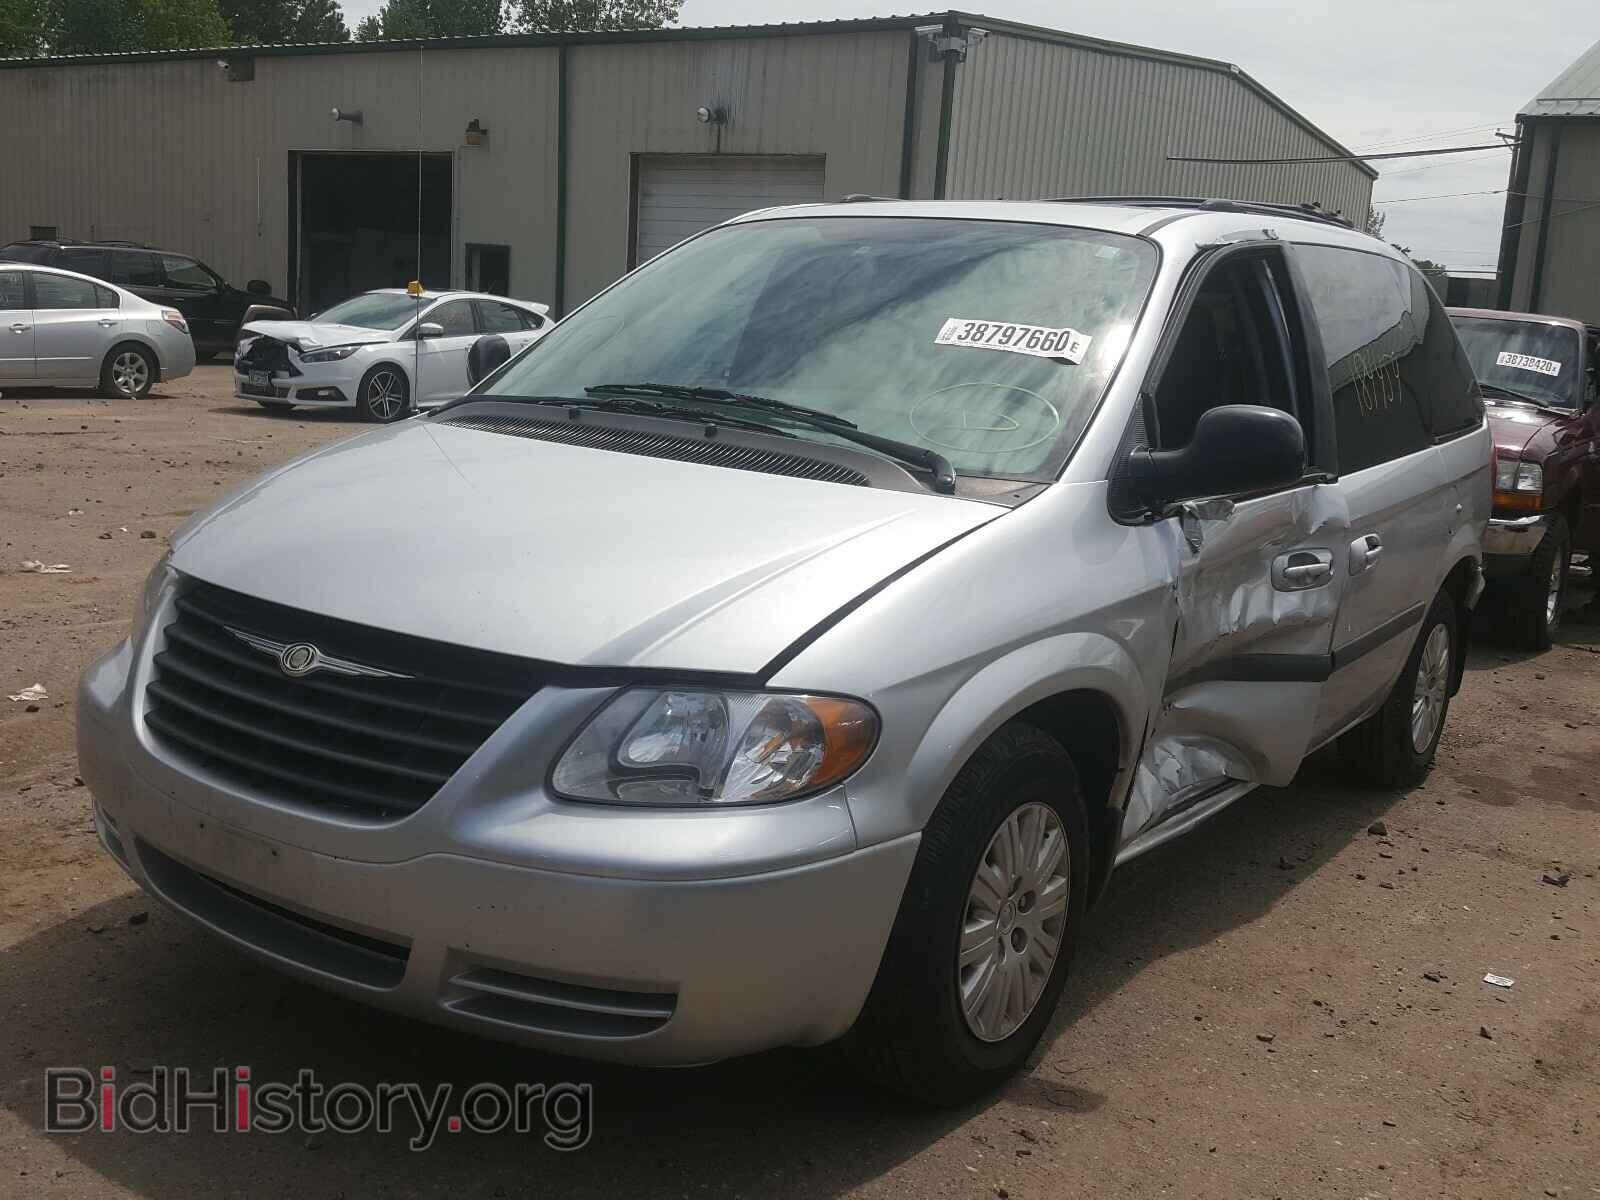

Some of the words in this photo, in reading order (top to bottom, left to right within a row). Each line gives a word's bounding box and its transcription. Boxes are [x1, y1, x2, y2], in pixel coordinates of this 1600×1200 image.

[957, 322, 1070, 352] 38797660
[1070, 341, 1080, 354] E
[1505, 354, 1553, 372] 38738420
